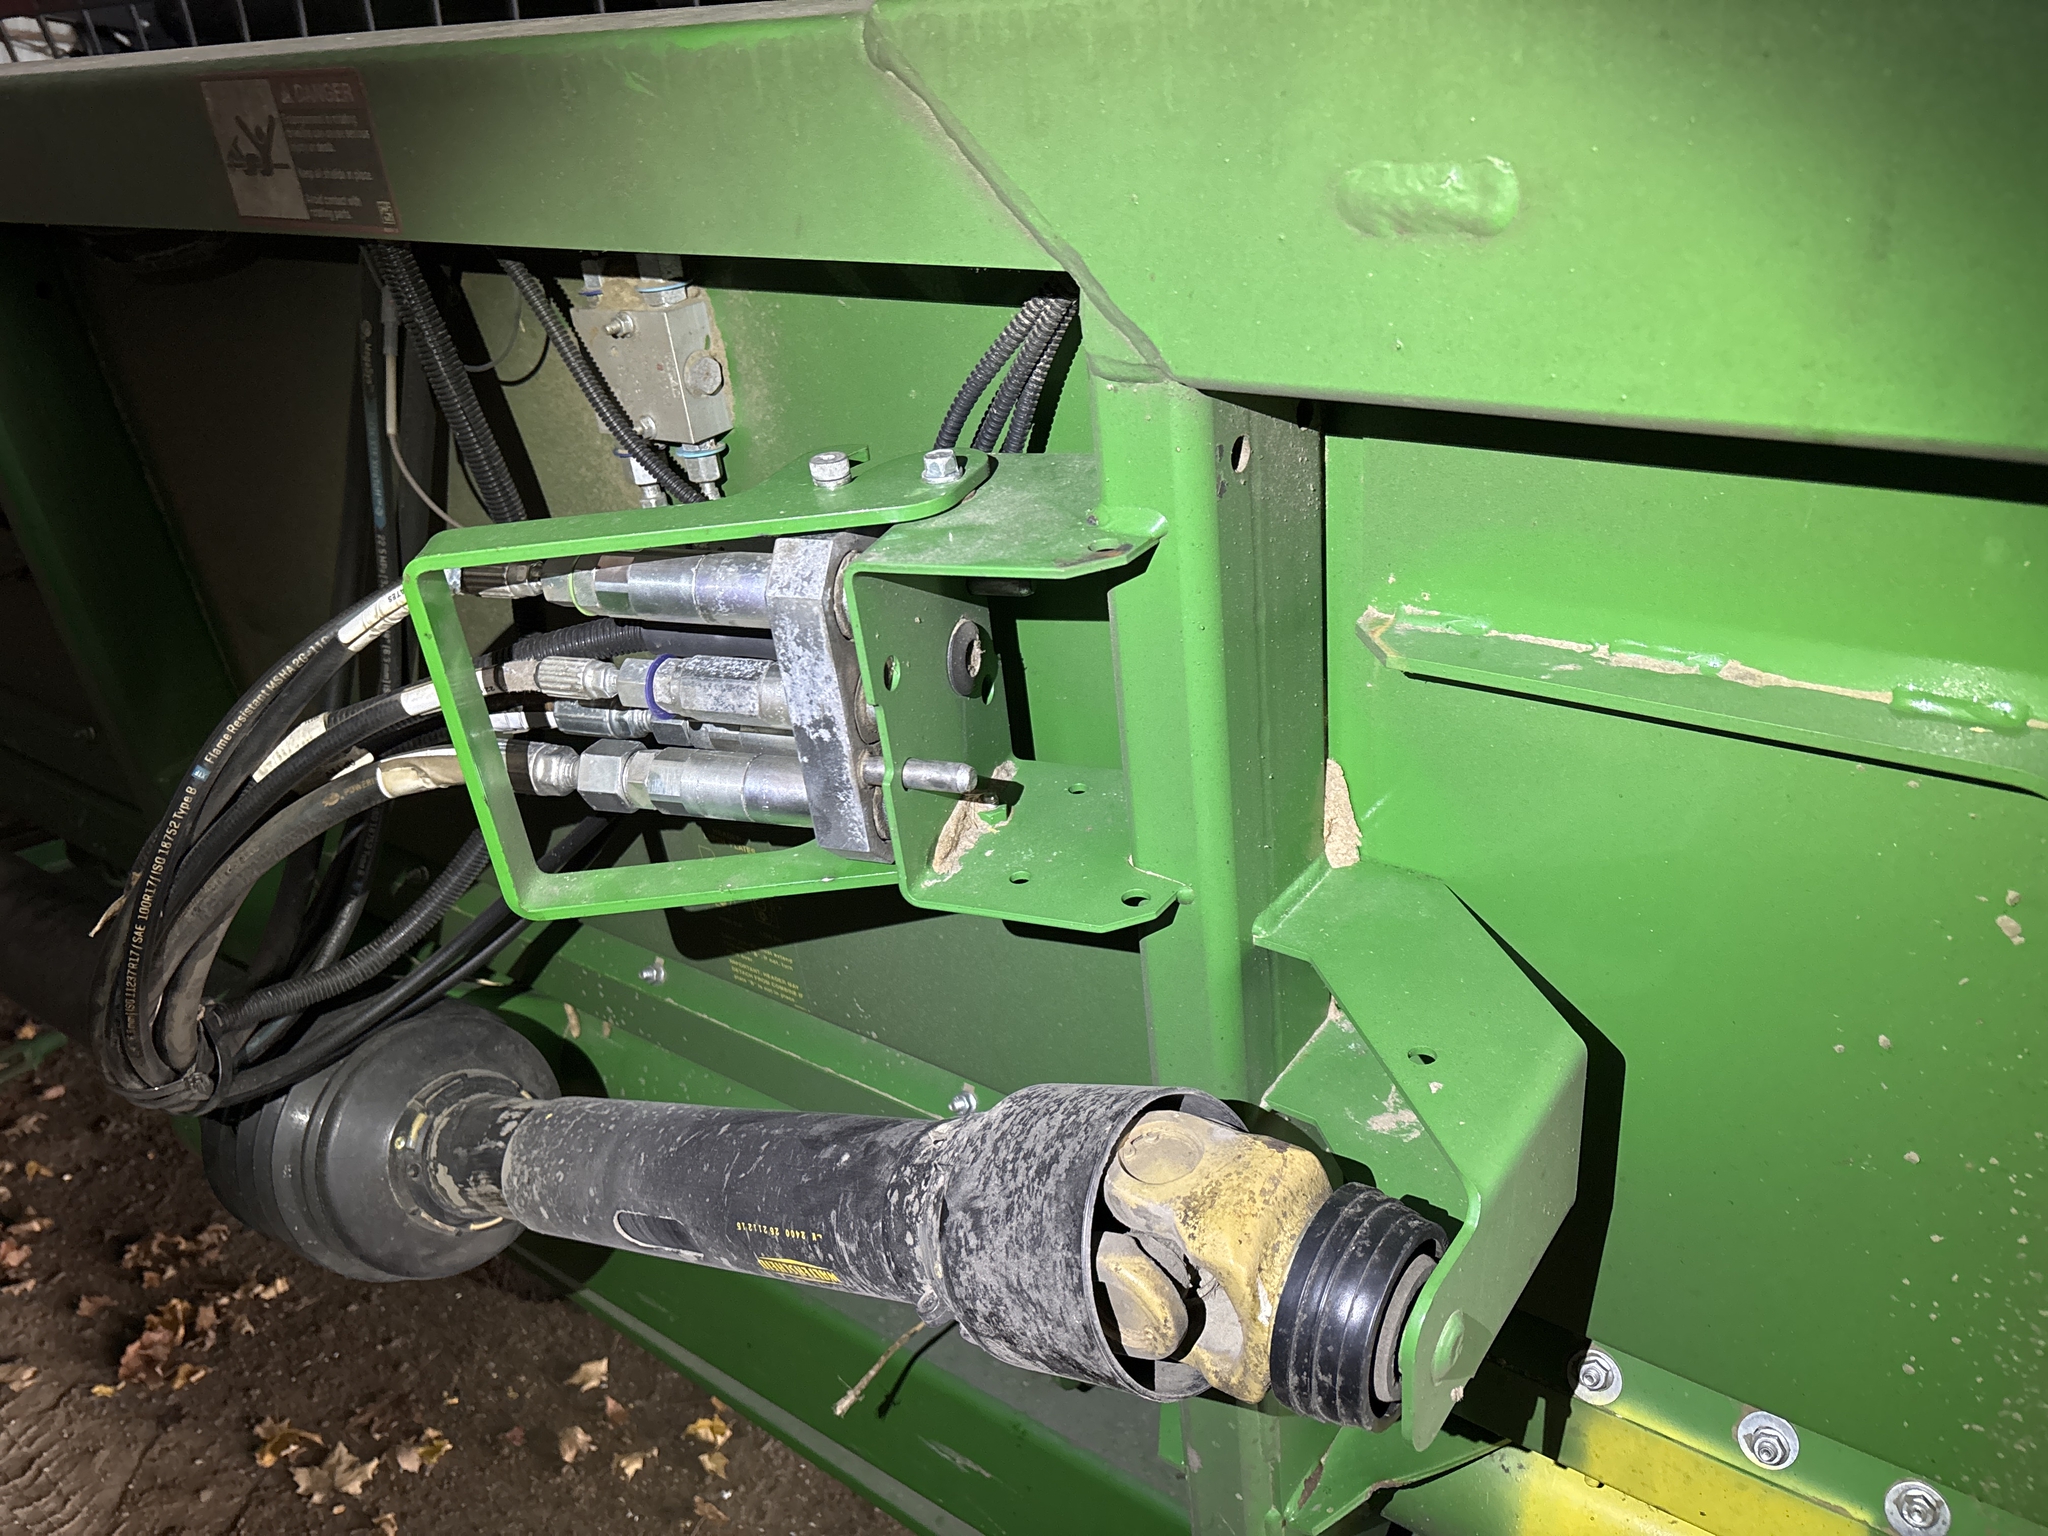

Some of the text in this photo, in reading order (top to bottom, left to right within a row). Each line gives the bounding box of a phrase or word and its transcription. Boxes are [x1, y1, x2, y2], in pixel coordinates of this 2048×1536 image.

[293, 83, 354, 102] DANGER
[157, 820, 181, 856] 18752
[172, 795, 193, 820] Type
[185, 785, 197, 796] B
[204, 733, 233, 765] Flame
[226, 689, 270, 735] Resistant
[265, 665, 296, 692] MSHA
